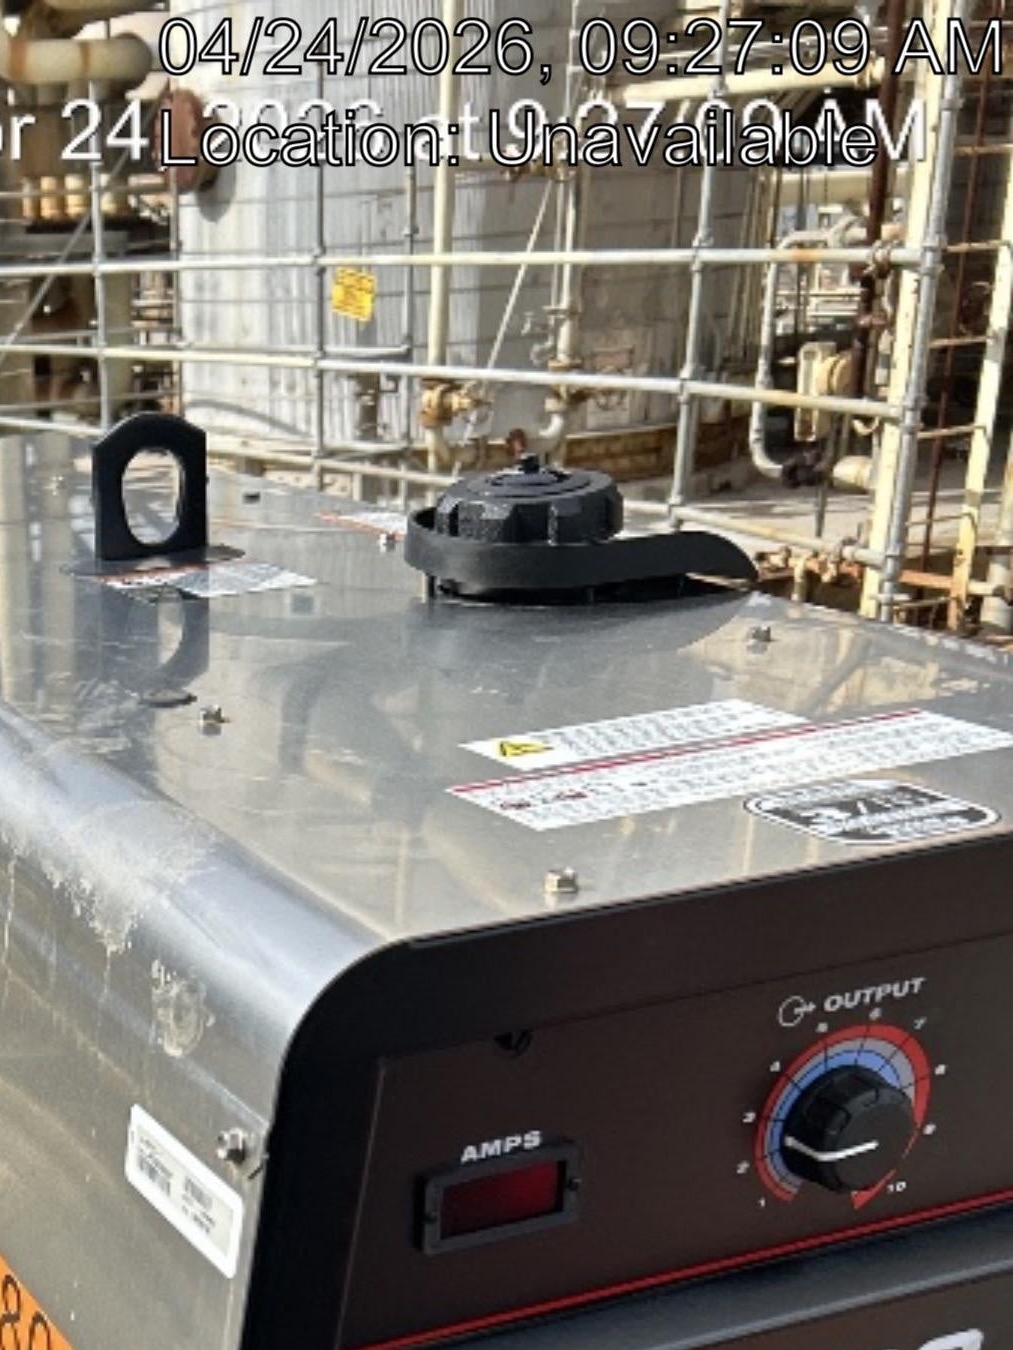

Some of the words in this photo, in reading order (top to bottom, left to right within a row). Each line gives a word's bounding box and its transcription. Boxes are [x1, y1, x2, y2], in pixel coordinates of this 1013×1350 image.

[824, 977, 926, 1012] OUTPUT
[460, 1129, 541, 1165] AMPS
[888, 1181, 907, 1192] 10
